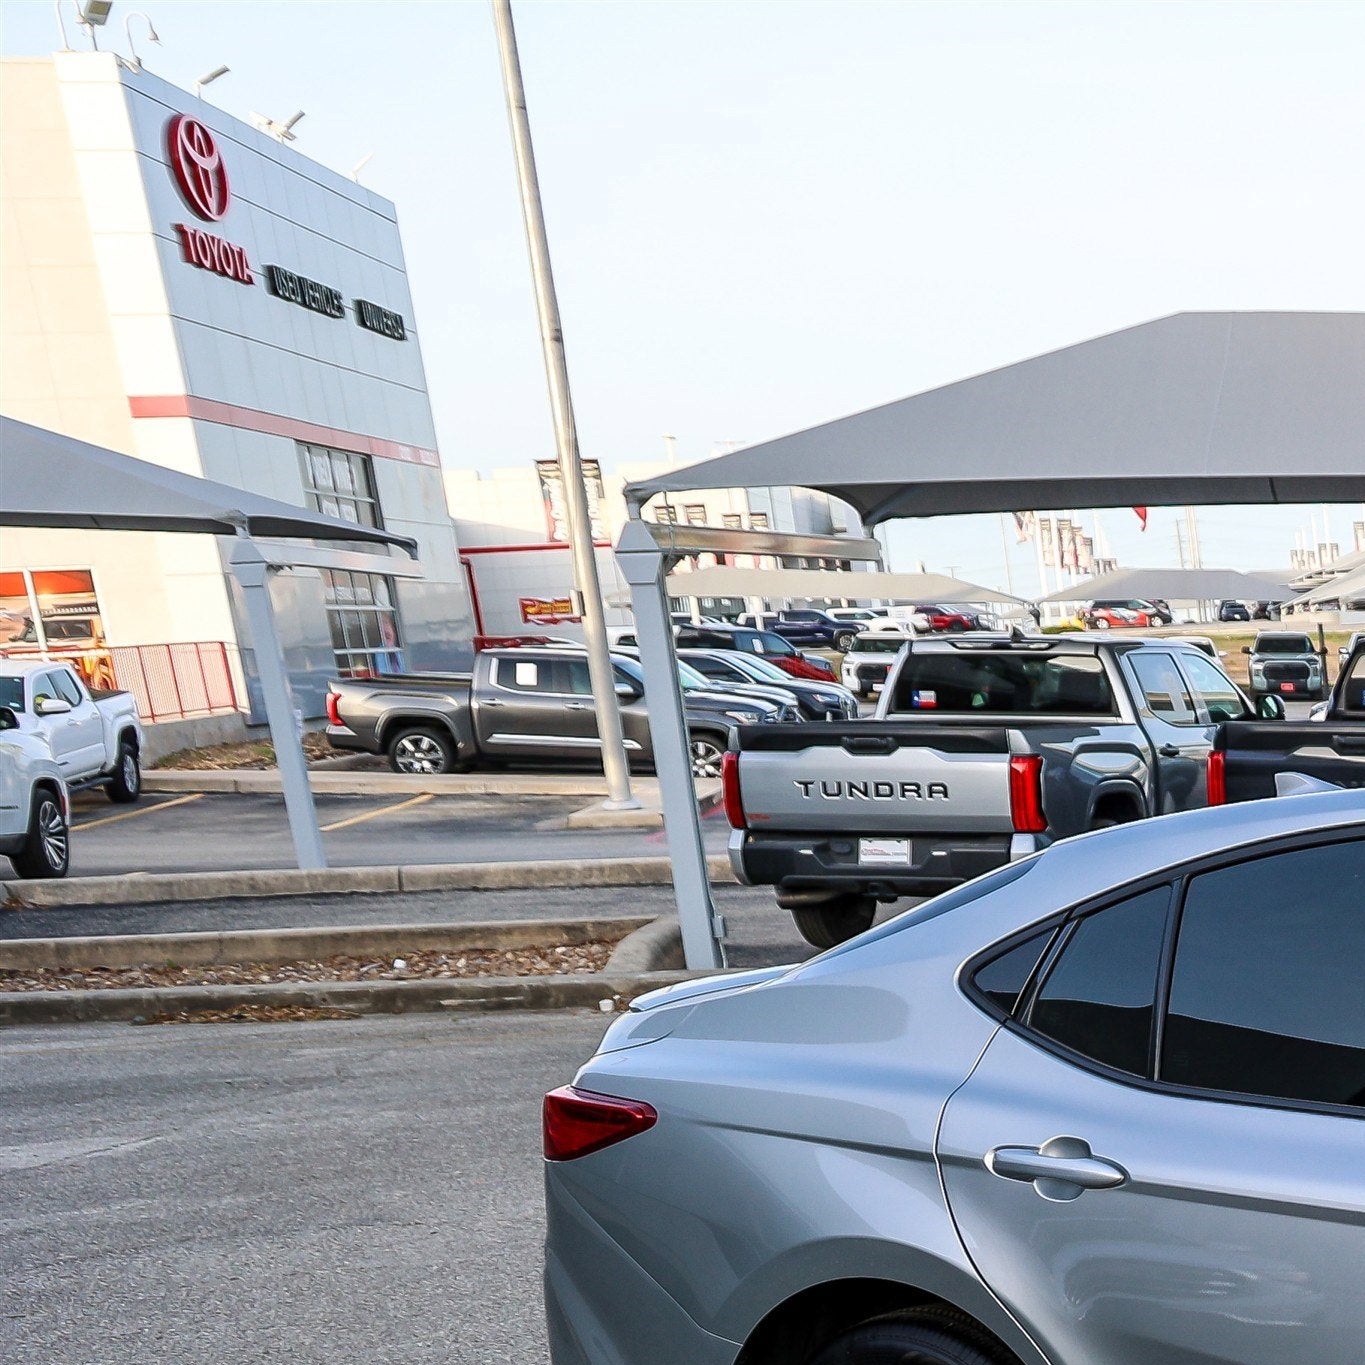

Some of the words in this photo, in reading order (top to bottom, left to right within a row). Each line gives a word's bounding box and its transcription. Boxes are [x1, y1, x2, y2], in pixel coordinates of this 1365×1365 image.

[178, 224, 255, 285] TOYOTA
[272, 265, 302, 302] USED
[300, 276, 345, 318] VEHICLES
[792, 779, 950, 801] TUNDRA
